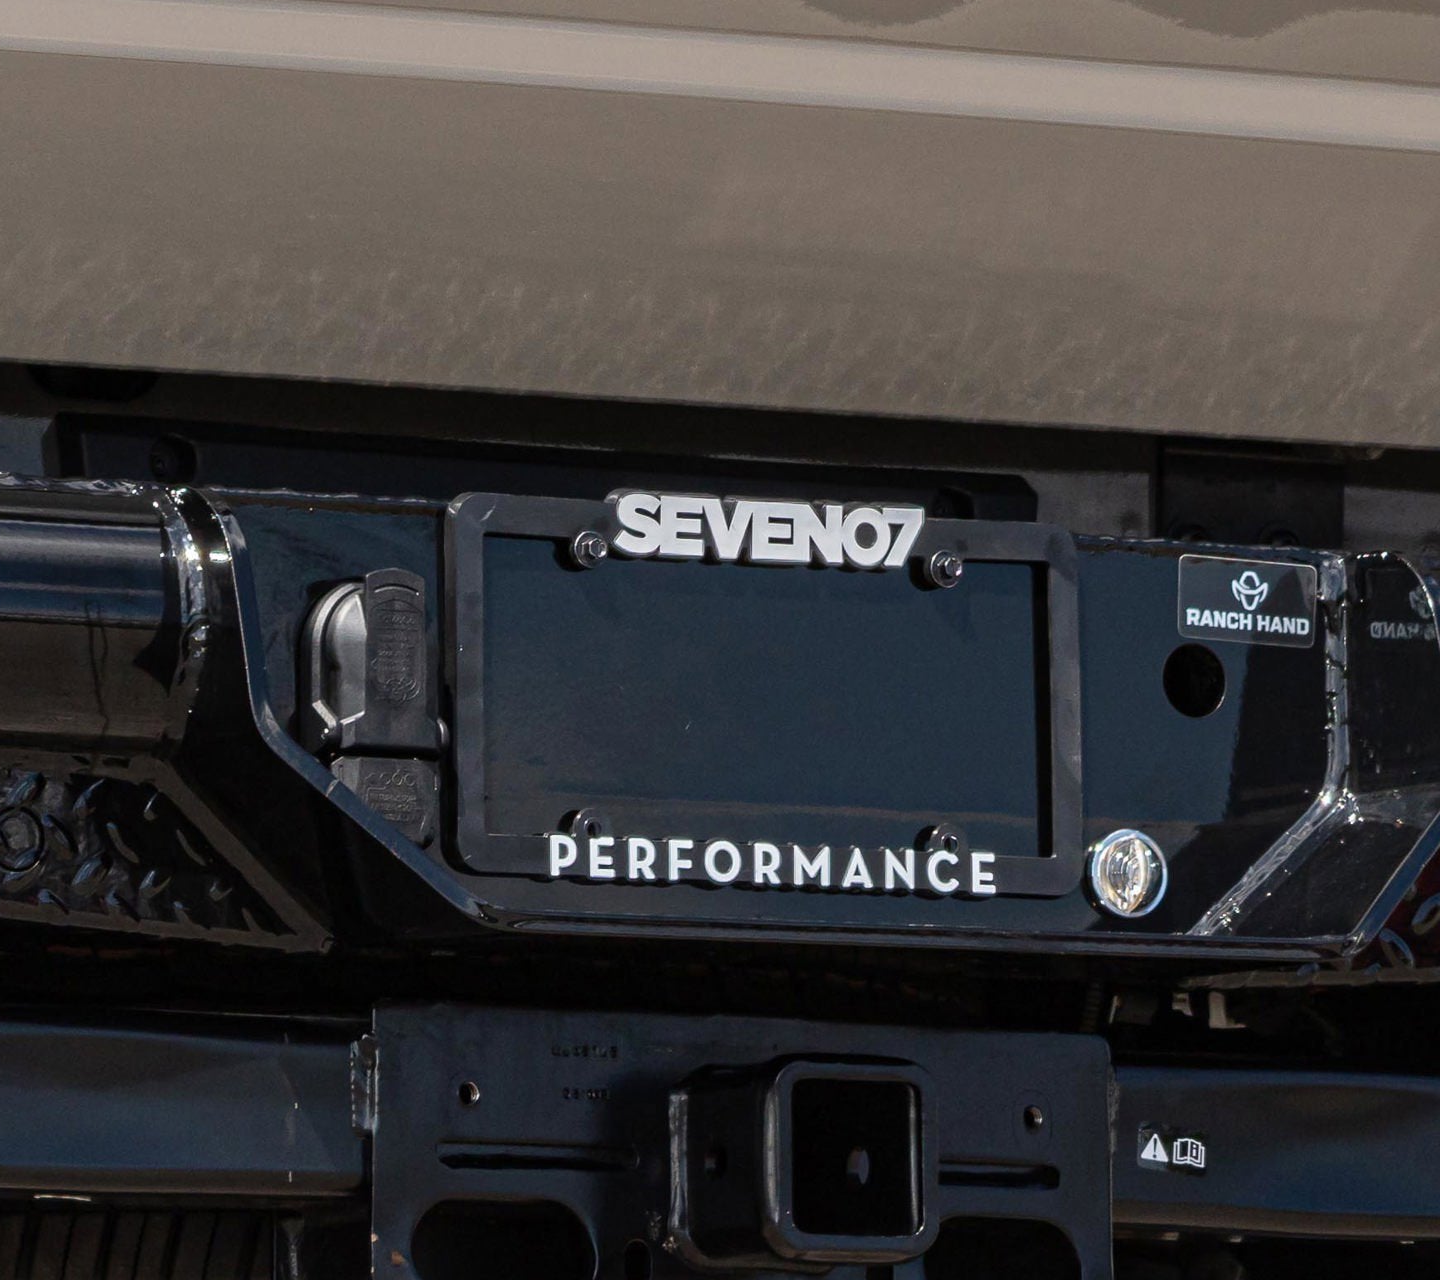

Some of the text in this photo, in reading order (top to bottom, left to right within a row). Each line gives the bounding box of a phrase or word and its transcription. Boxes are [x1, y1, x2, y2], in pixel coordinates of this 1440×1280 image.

[1185, 607, 1311, 637] RANCH HAND
[548, 834, 997, 894] PERFORMANCE
